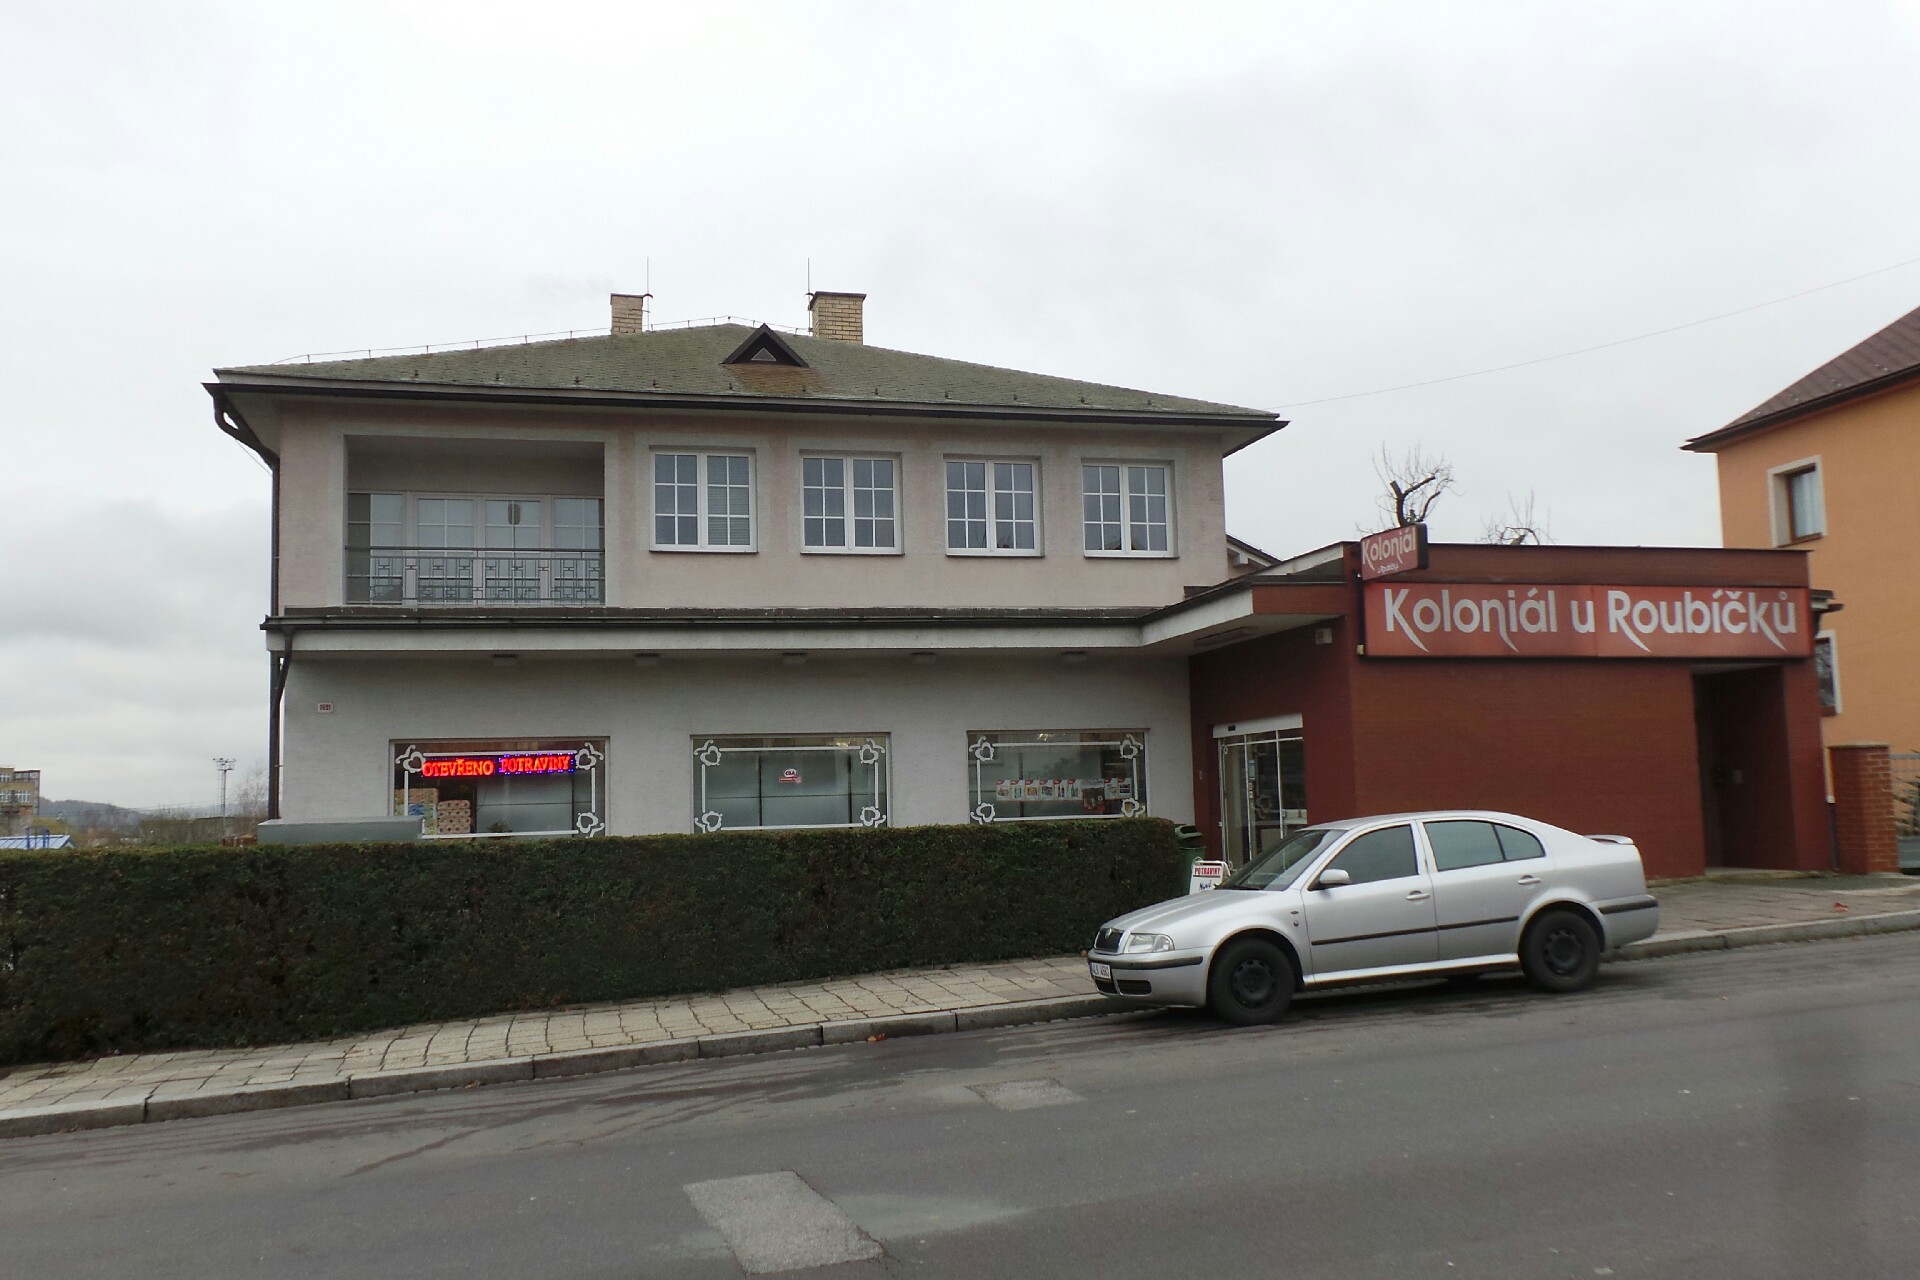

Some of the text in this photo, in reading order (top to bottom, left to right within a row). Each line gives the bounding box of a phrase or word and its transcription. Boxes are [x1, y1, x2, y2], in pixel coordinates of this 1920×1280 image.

[1362, 526, 1416, 571] Koloniál
[1384, 587, 1797, 653] Koloniál u Roubíčků
[422, 755, 571, 777] OTEVŘENO POTRAVINY
[1194, 867, 1220, 875] POTRAVINY
